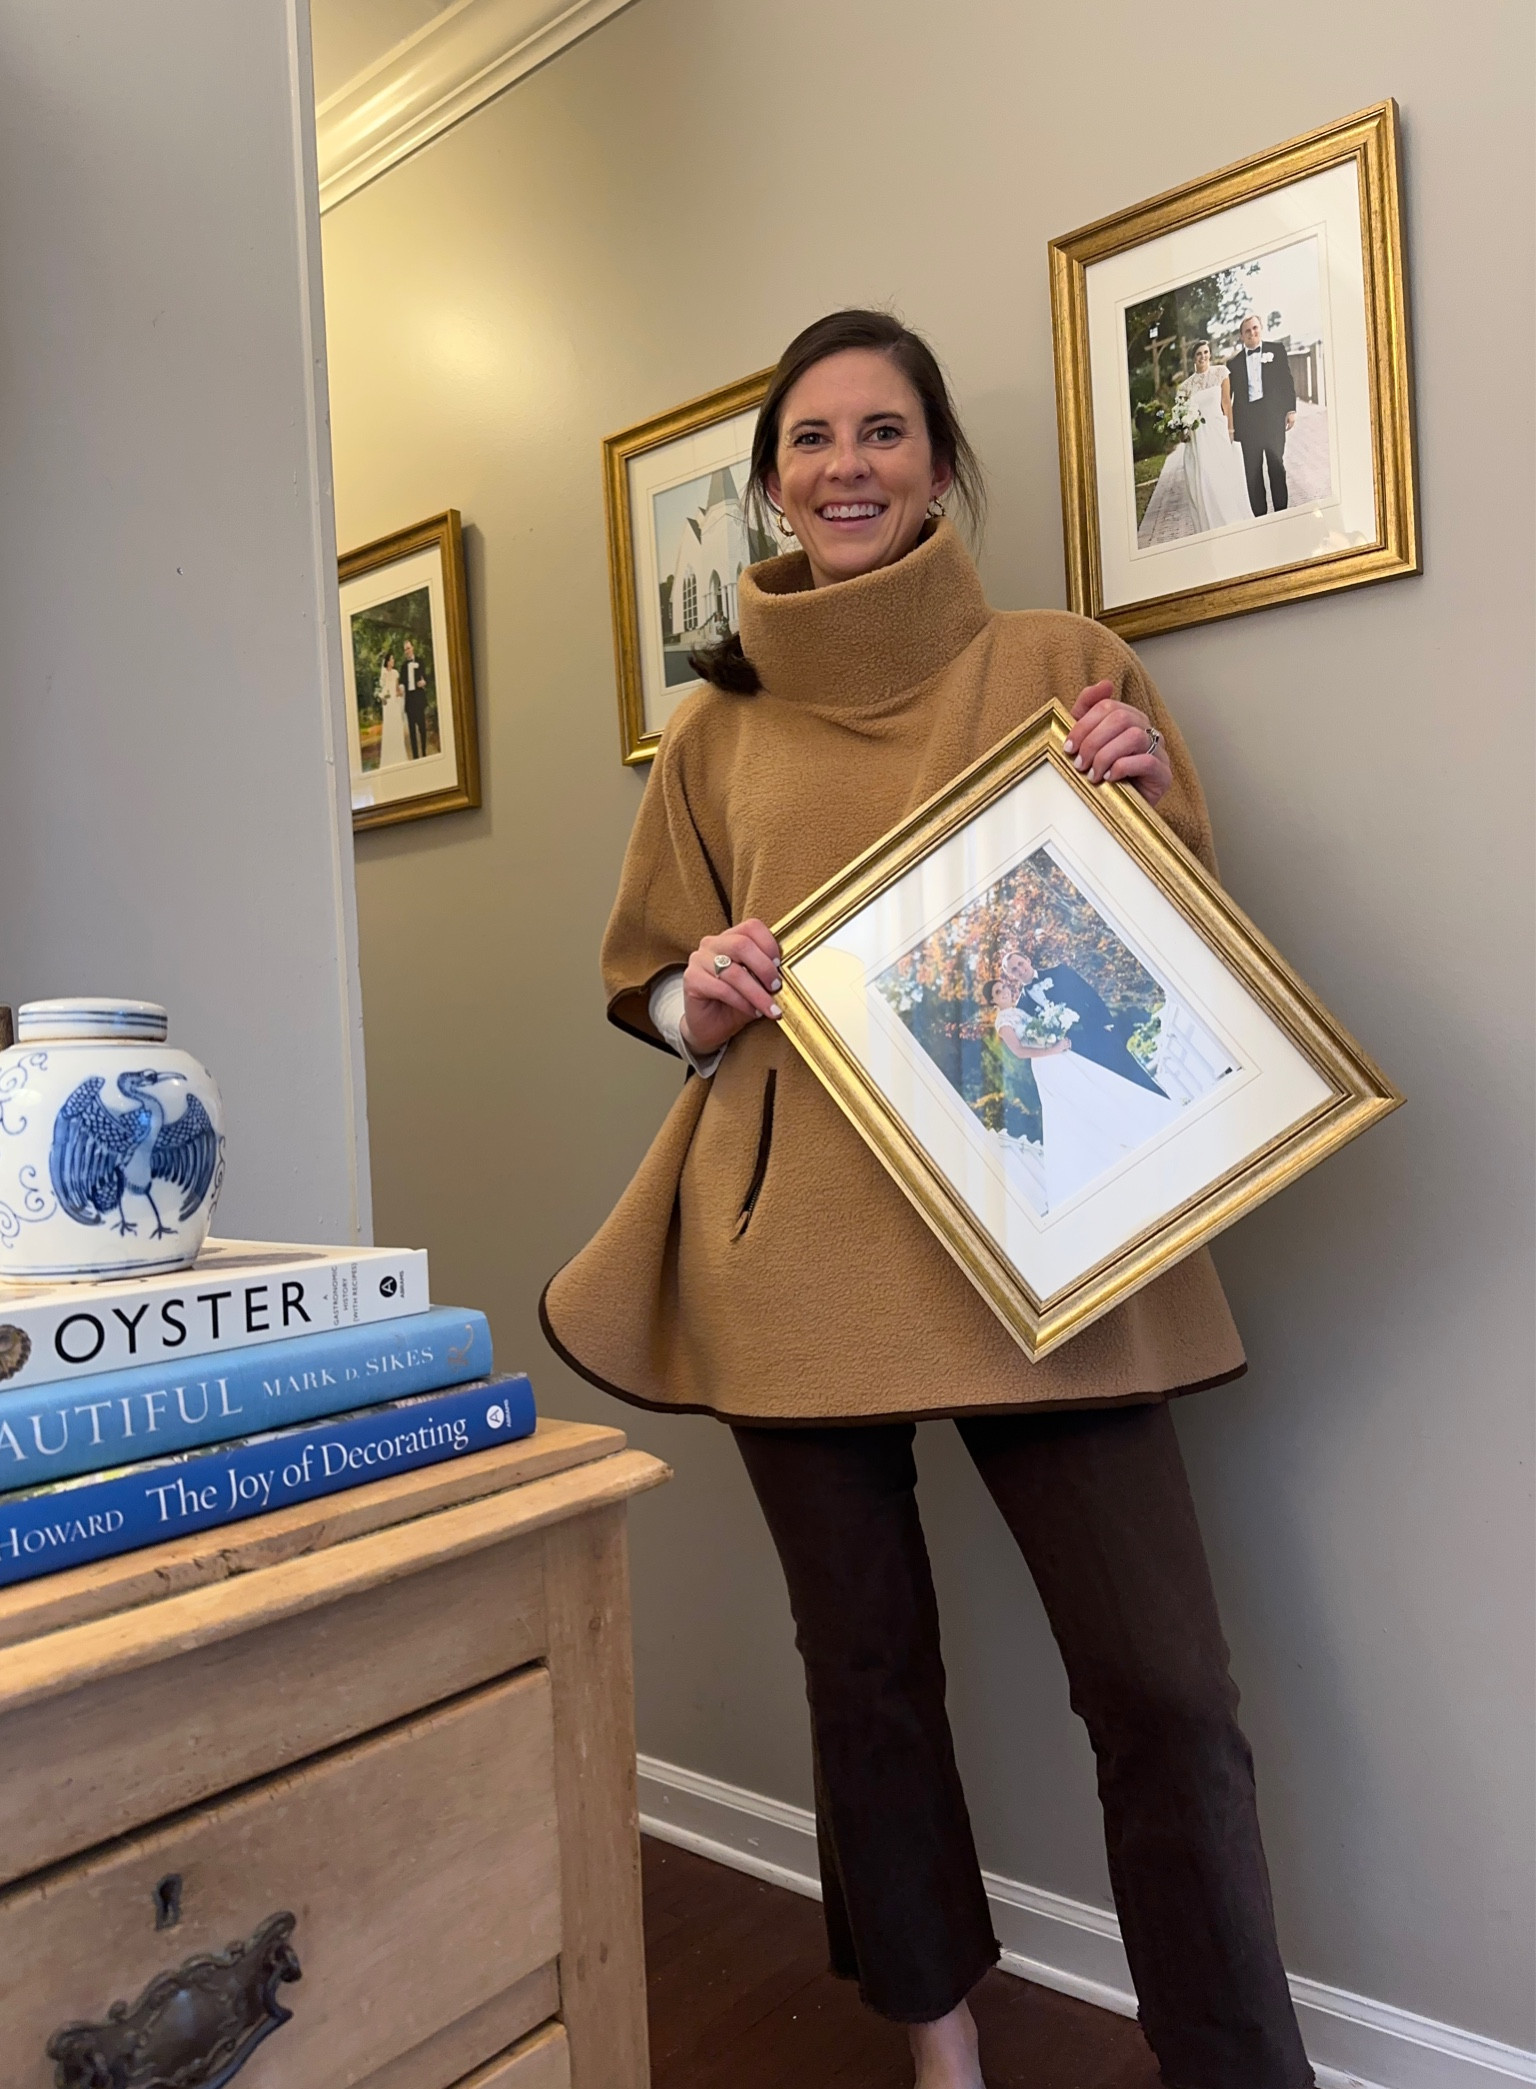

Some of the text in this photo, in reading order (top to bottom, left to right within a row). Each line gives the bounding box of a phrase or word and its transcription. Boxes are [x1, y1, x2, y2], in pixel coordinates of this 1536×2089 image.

[54, 1281, 312, 1364] OYSTER
[331, 1265, 340, 1326] GASTRONOMIC
[262, 1369, 337, 1398] MARK
[365, 1346, 434, 1377] SIKES
[0, 1377, 243, 1461] AUTIFUL
[145, 1416, 469, 1522] The Joy of Decorating
